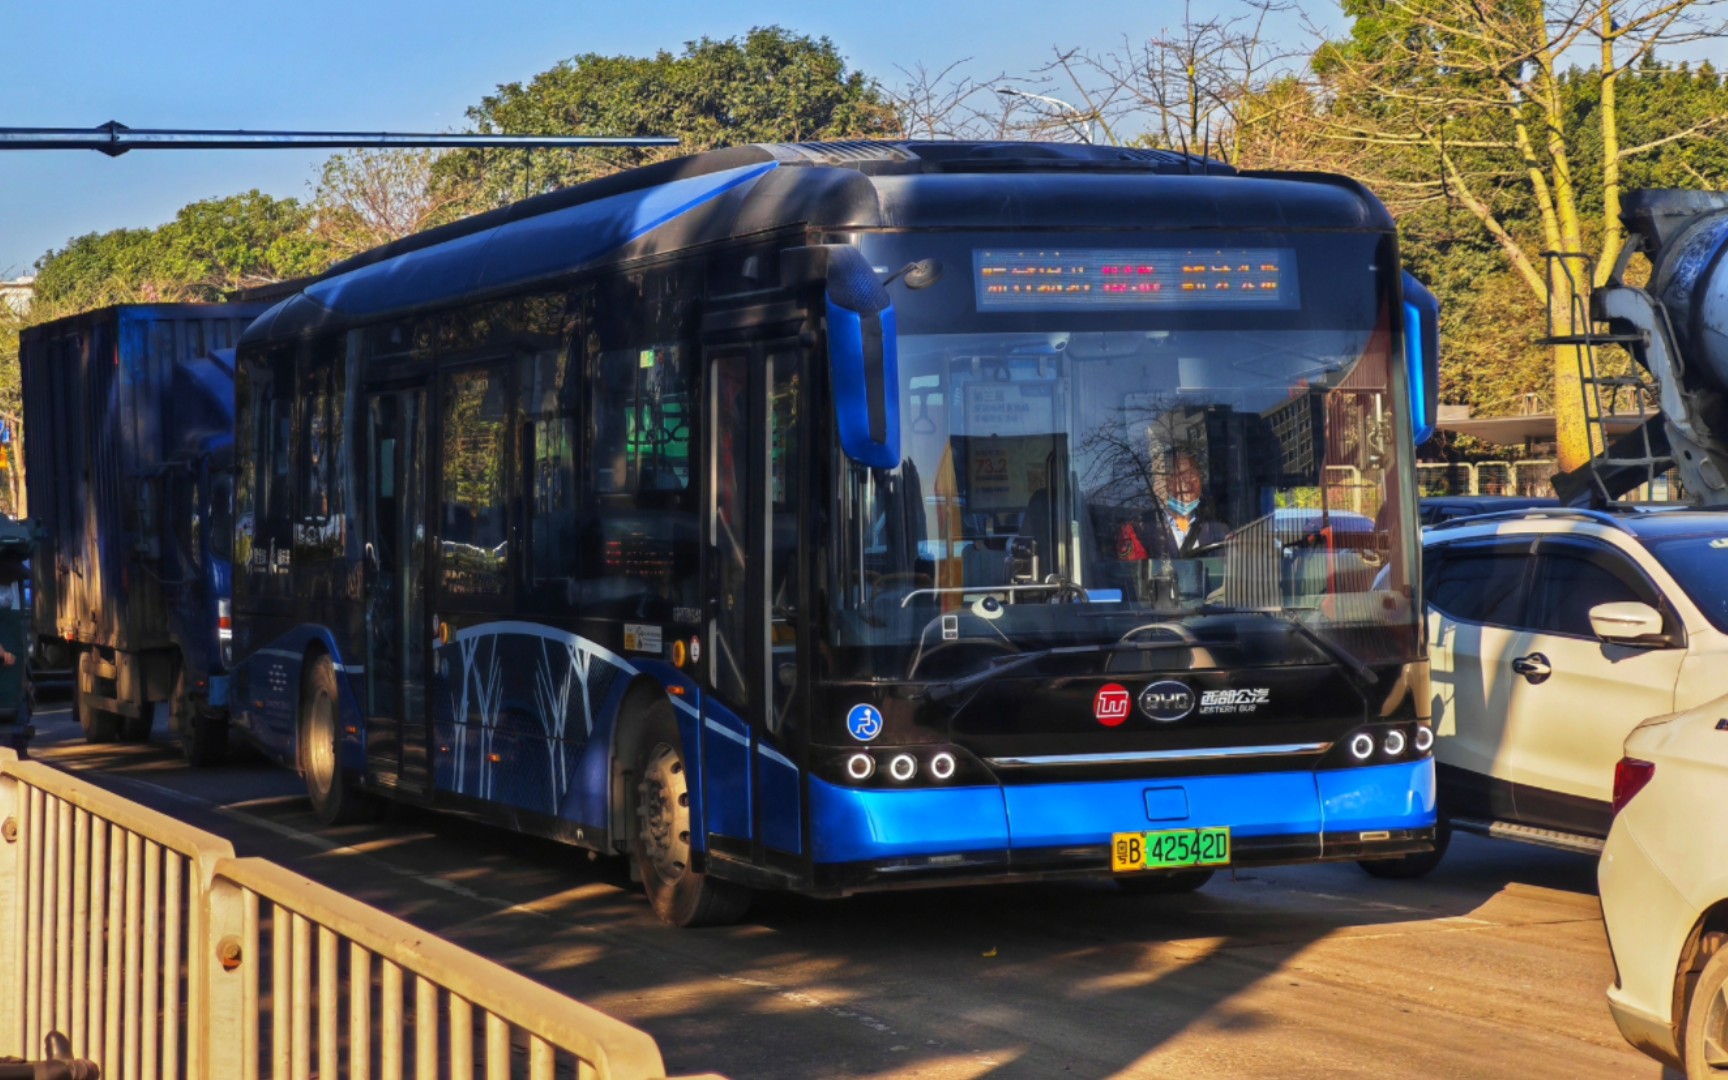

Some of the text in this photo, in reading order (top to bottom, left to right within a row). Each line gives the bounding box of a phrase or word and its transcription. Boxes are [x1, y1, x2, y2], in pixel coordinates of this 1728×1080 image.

[1146, 692, 1189, 710] BYD
[1200, 688, 1271, 705] 西部公汽
